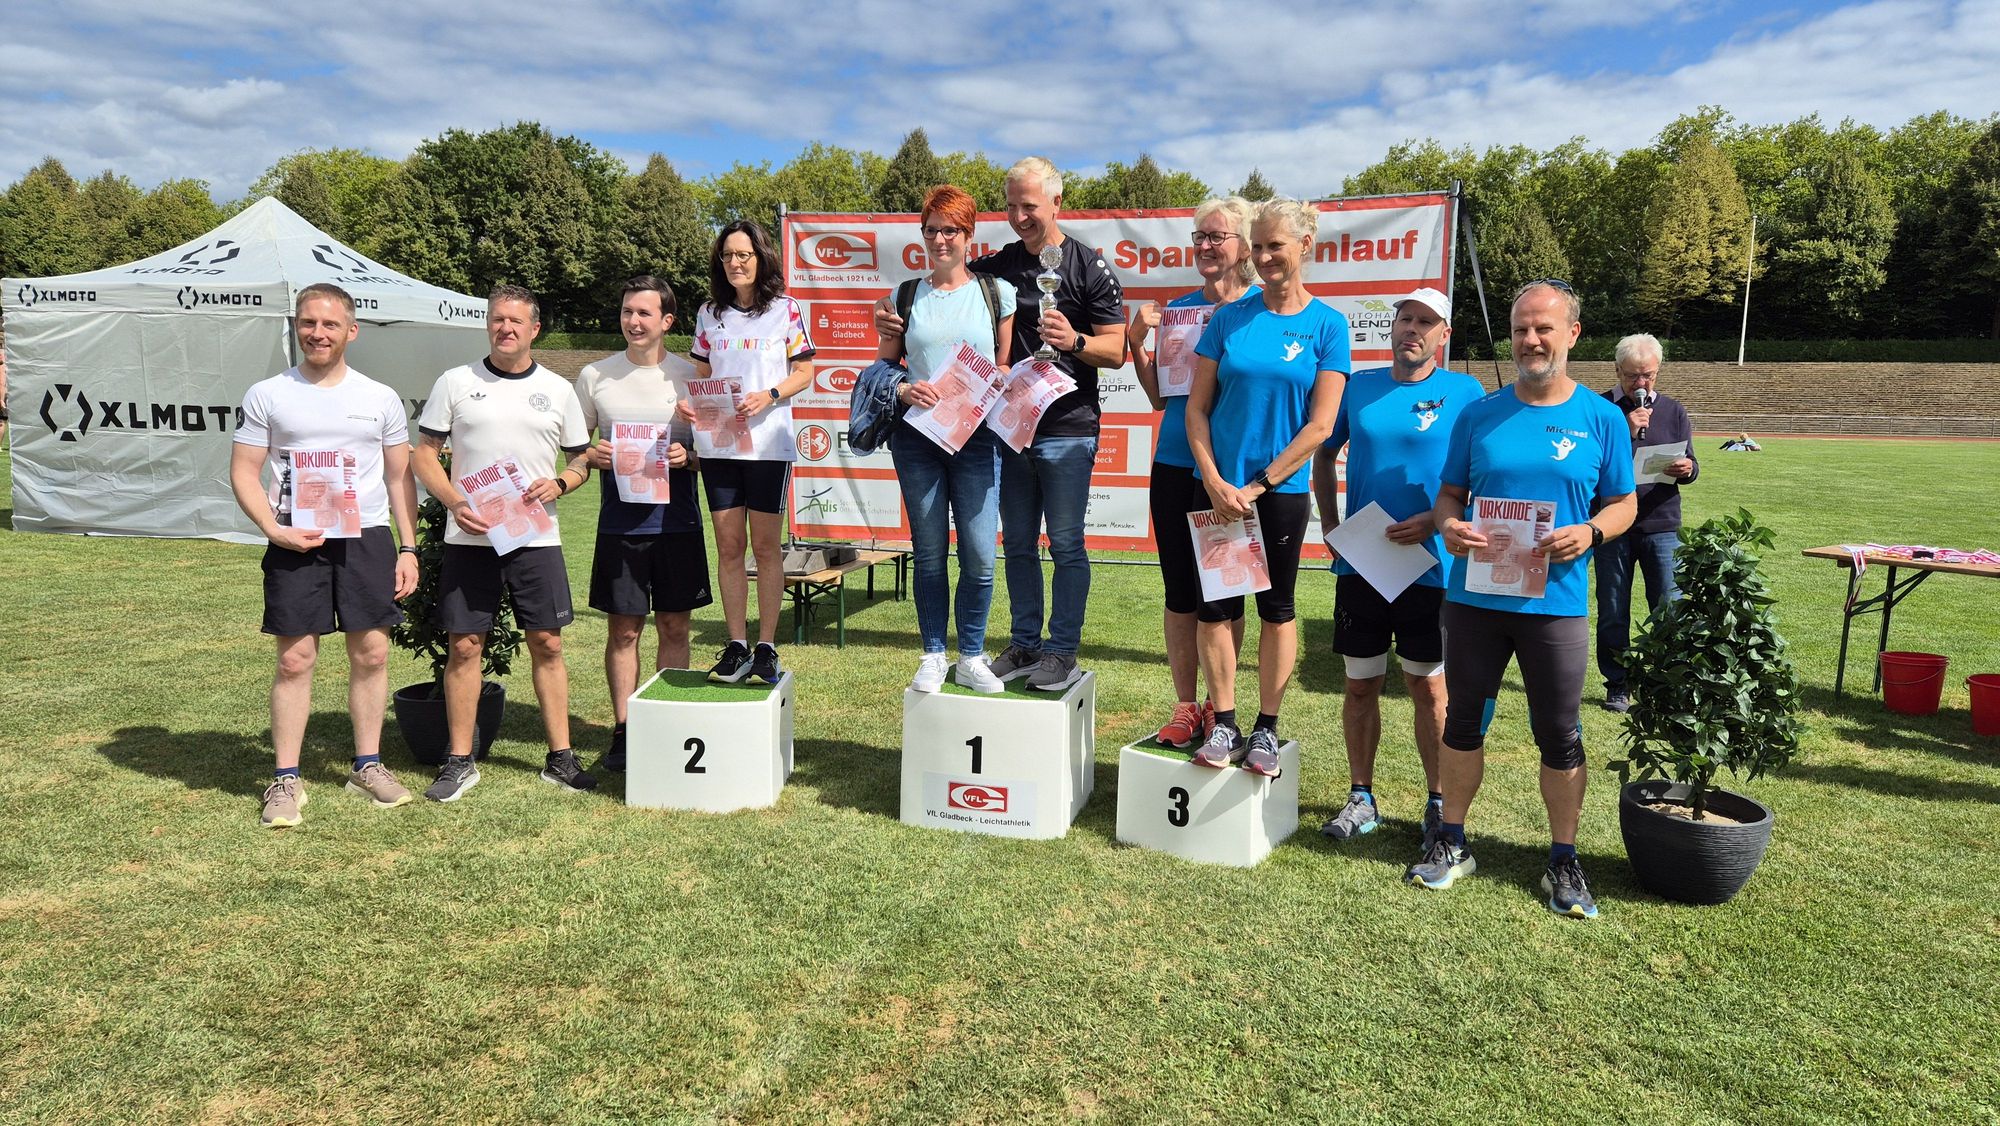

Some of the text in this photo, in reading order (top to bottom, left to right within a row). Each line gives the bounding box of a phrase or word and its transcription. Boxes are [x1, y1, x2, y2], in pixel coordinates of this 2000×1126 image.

[816, 247, 842, 258] VFL
[125, 268, 226, 276] XLMOTO
[808, 274, 844, 282] Gladbeck
[334, 276, 413, 287] XLMOTO
[41, 290, 97, 302] XLMOTO
[202, 293, 262, 306] XLMOTO
[355, 298, 378, 310] OTO
[455, 307, 487, 319] XLMOT
[1162, 308, 1201, 326] URKUNDE
[832, 320, 869, 330] Sparkasse
[832, 330, 865, 339] Gladbeck
[713, 339, 771, 351] LOVE UNITES
[956, 344, 997, 383] URKUNDE
[831, 377, 851, 385] VFL
[687, 380, 728, 396] URKUNDE
[616, 424, 654, 439] URKUNDE
[295, 451, 339, 468] URKUNDE
[460, 464, 504, 494] URKUNDE
[1479, 500, 1533, 522] URKUNDE
[1193, 511, 1236, 529] URKU
[683, 738, 707, 774] 2
[965, 735, 983, 774] 1
[963, 794, 983, 803] VFL
[1167, 786, 1190, 827] 3
[926, 809, 938, 818] VfL
[939, 811, 973, 823] Gladbeck
[979, 816, 1032, 827] Leichtathletik
